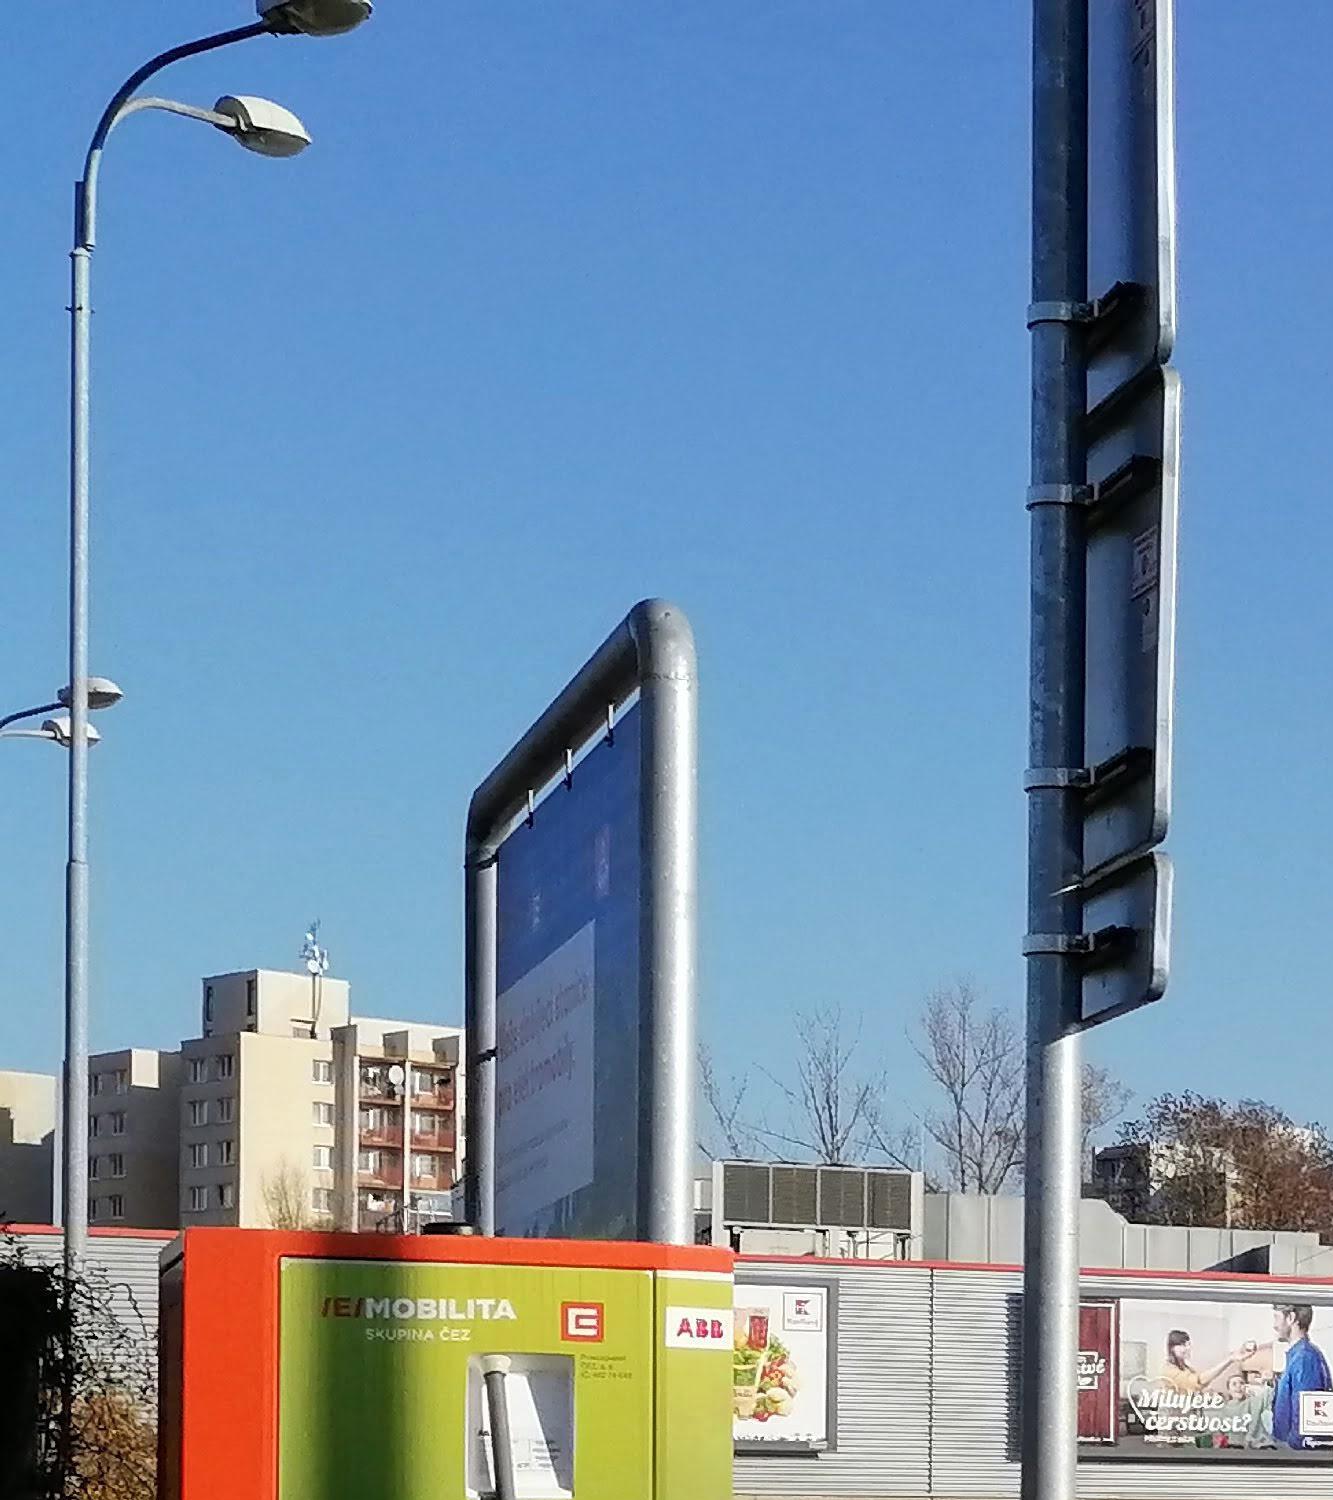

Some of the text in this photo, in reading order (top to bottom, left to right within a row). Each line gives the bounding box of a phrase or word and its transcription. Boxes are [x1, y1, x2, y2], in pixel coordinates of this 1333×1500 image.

[366, 1326, 471, 1342] SKUPINA ČEZ
[677, 1317, 724, 1339] ABB
[1137, 1388, 1224, 1414] Milujete
[1144, 1410, 1252, 1433] čerstvost?
